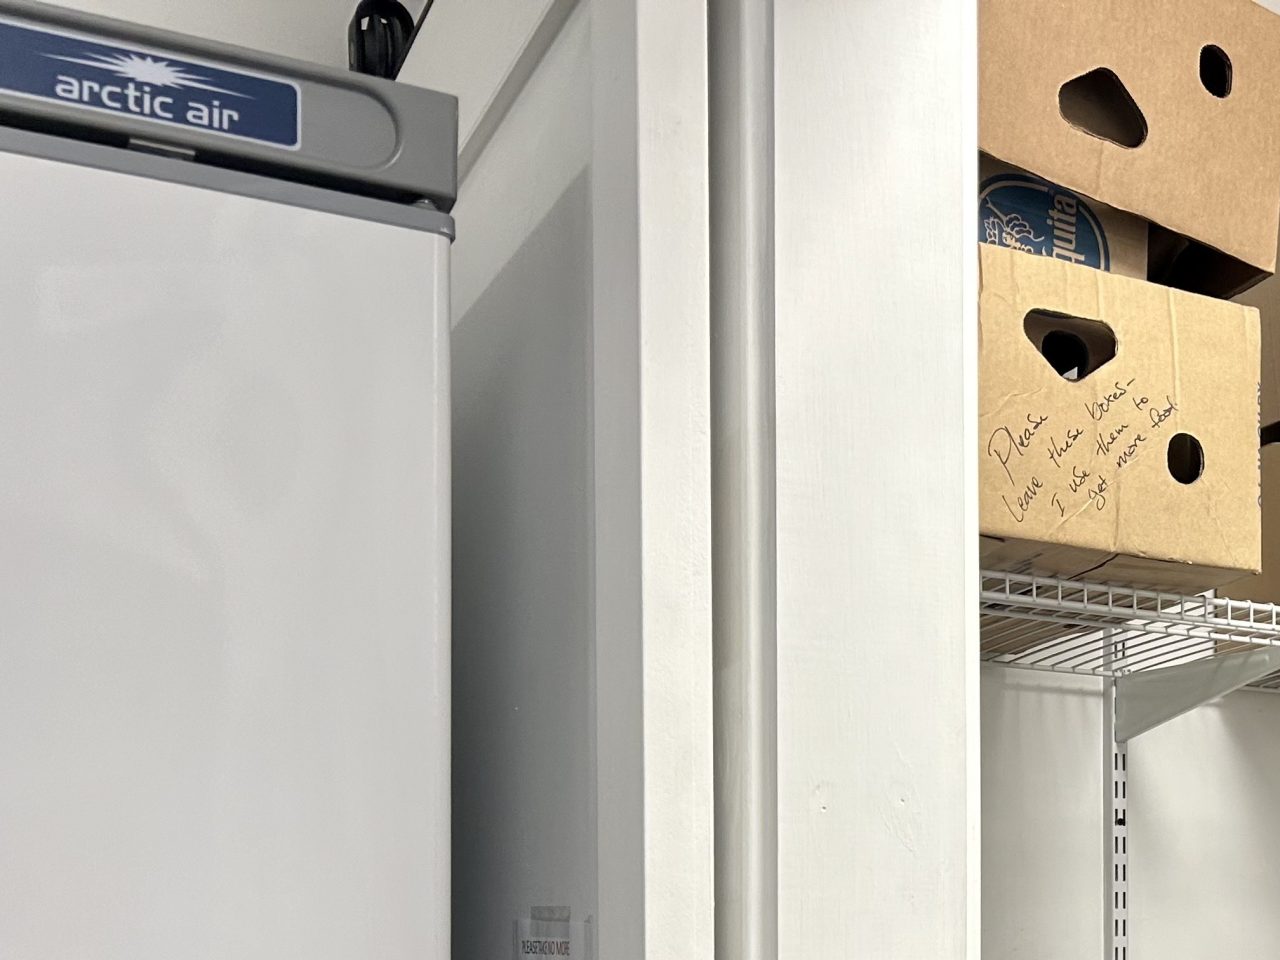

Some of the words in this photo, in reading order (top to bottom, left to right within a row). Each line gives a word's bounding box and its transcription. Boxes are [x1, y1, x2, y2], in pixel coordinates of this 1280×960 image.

[55, 75, 174, 119] arctic
[186, 100, 240, 130] air
[1046, 194, 1085, 263] quita
[988, 413, 1048, 487] Please
[1047, 428, 1084, 468] these
[1051, 492, 1065, 517] I
[1069, 466, 1090, 493] use
[1096, 424, 1128, 456] them
[1132, 396, 1149, 411] to
[1088, 475, 1108, 511] get
[1116, 433, 1147, 469] more
